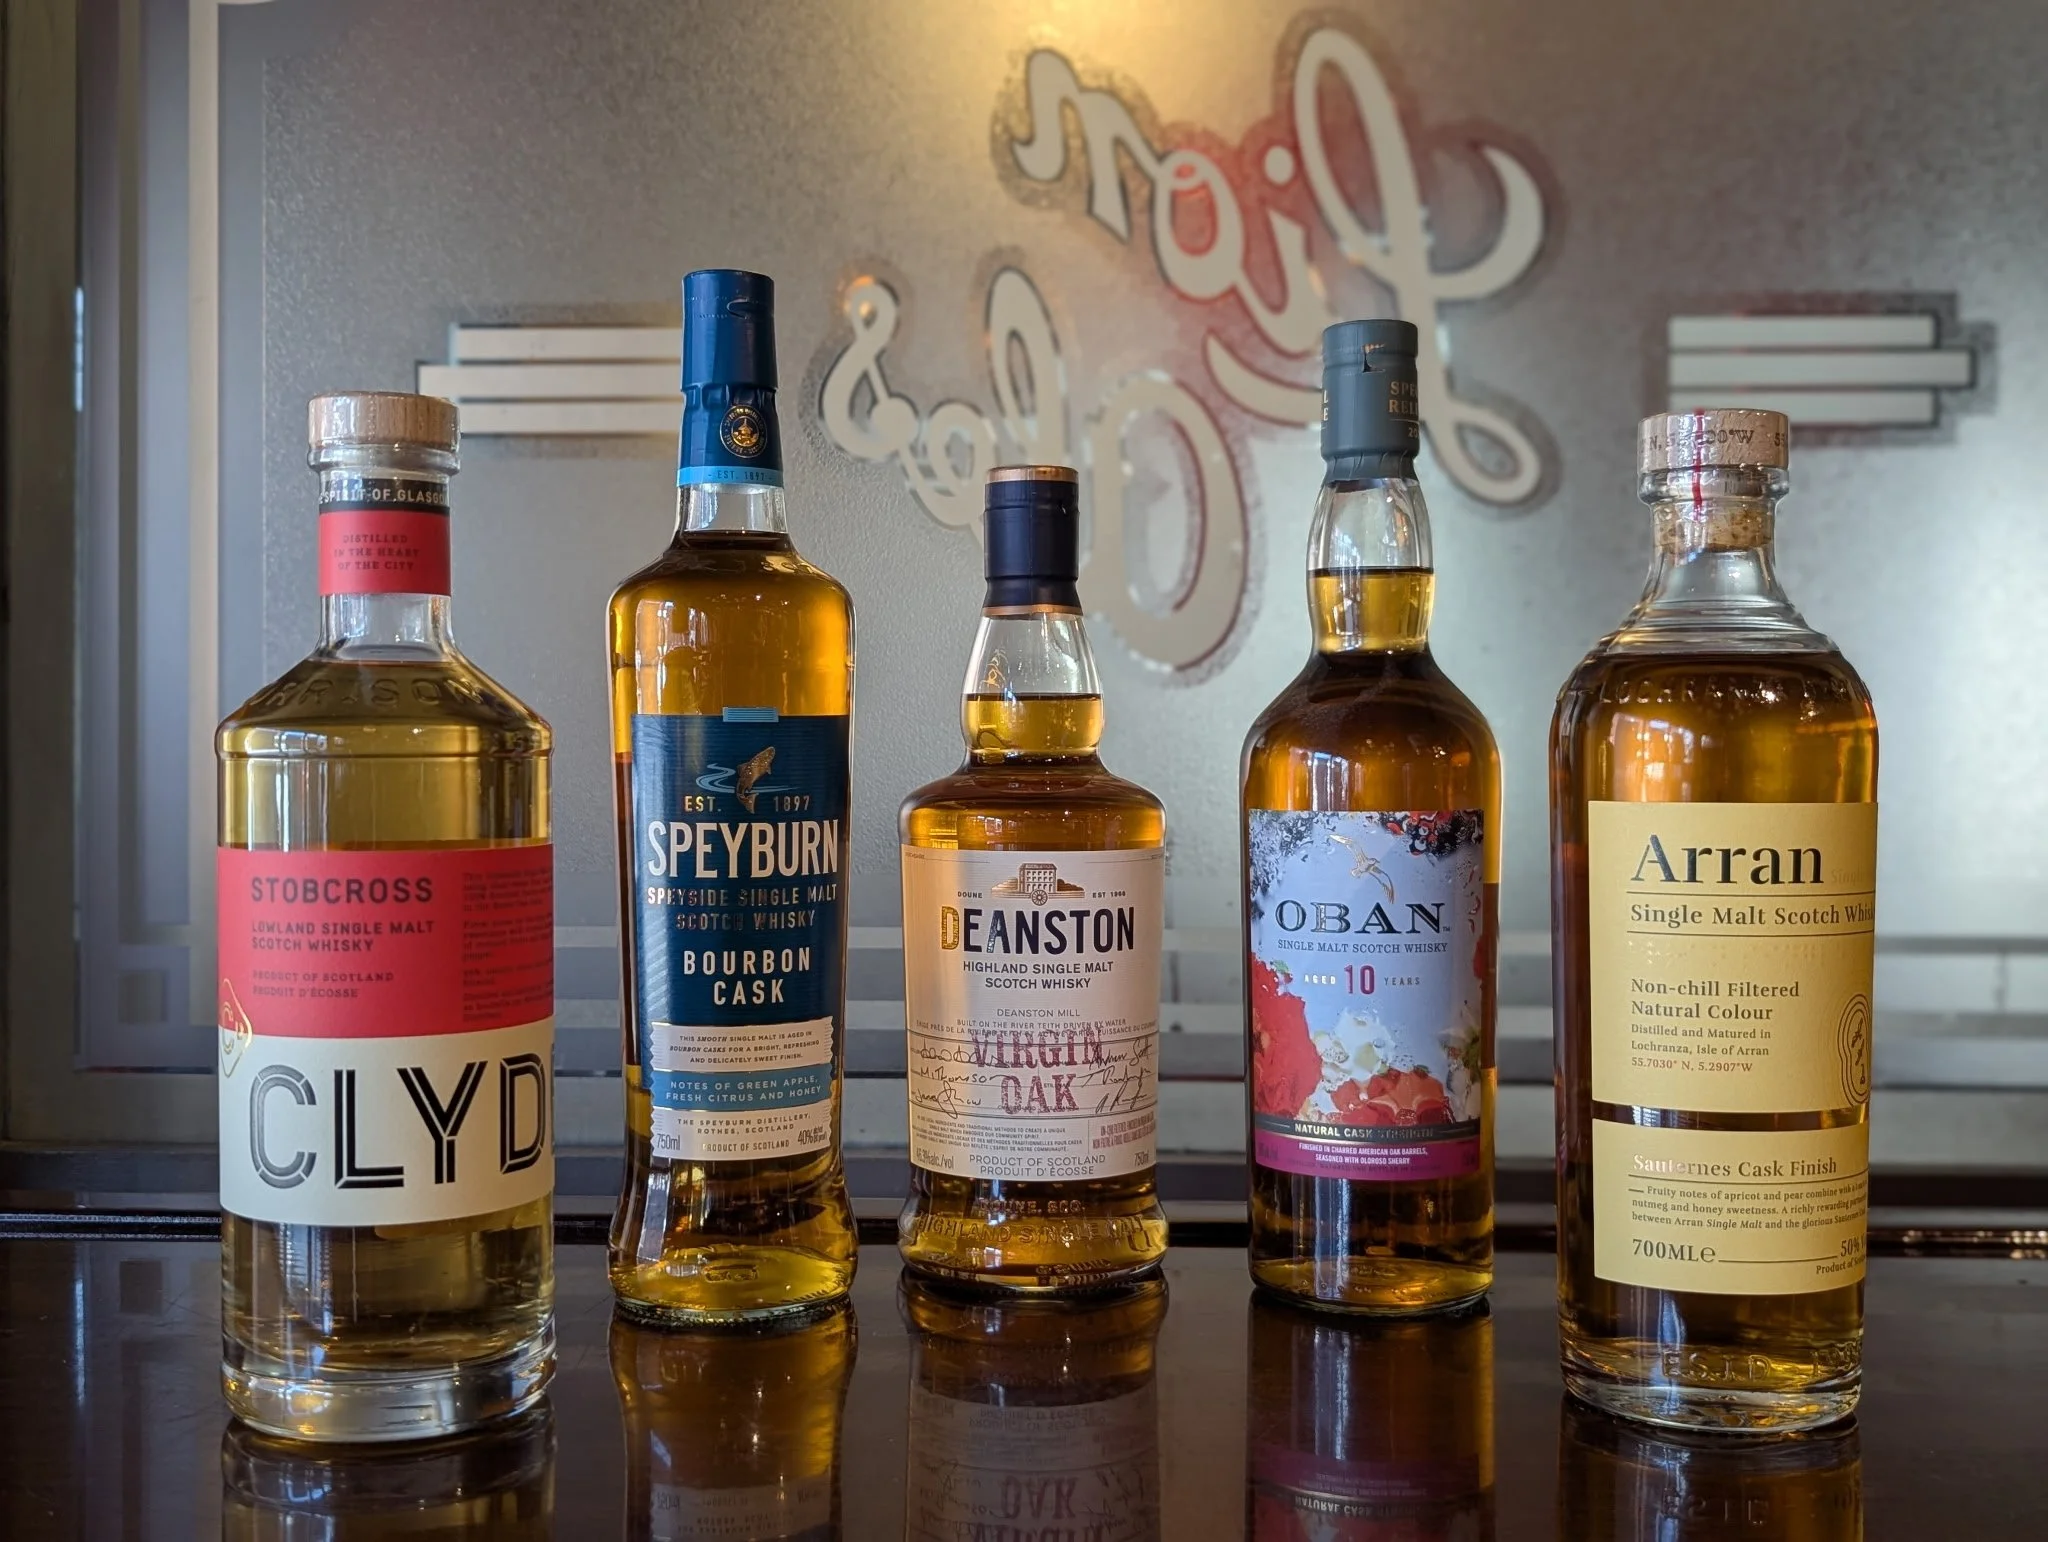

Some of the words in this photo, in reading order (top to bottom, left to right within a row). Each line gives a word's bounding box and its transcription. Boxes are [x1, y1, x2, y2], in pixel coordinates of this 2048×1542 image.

[372, 488, 392, 501] OF
[343, 534, 408, 544] DISTILLED
[350, 548, 372, 556] THE
[378, 548, 419, 558] HEART
[355, 562, 379, 570] THE
[384, 562, 414, 570] CITY
[685, 796, 721, 812] EST.
[774, 796, 811, 812] 1897
[648, 820, 838, 879] SPEYBURN
[1631, 834, 1824, 884] Arran
[252, 877, 433, 904] STOBCROSS
[648, 886, 728, 907] SPEYSIDE
[738, 887, 799, 907] SINGLE
[808, 884, 837, 903] MALT
[957, 891, 983, 899] DOUNE
[677, 912, 743, 930] SCOTCH
[754, 910, 815, 930] WHISKY
[1275, 899, 1444, 934] OBAN
[1631, 904, 1702, 928] Single
[1712, 906, 1766, 925] Malt
[1774, 906, 1840, 925] Scotch
[252, 922, 315, 935] LOWLAND
[322, 921, 382, 935] SINGLE
[390, 920, 434, 934] MALT
[941, 906, 1135, 954] DEANSTON
[252, 937, 302, 951] SCOTCH
[308, 938, 373, 952] WHISKY
[1278, 939, 1313, 950] SINGLE
[1317, 943, 1348, 953] MALT
[1353, 944, 1400, 954] SCOTCH
[1404, 943, 1448, 953] WHISKY
[684, 947, 810, 976] BOURBON
[963, 961, 1028, 974] HIGHLAND
[1032, 963, 1080, 974] SINGLE
[1085, 962, 1113, 973] MALT
[252, 970, 299, 982] PRODUCT
[303, 971, 318, 982] OF
[322, 972, 394, 982] SCOTLAND
[985, 978, 1037, 989] SCOTCH
[1041, 978, 1091, 989] WHISKY
[1305, 974, 1336, 984] AGED
[1344, 964, 1375, 995] 10
[1384, 977, 1420, 986] YEARS
[252, 986, 295, 998] PRODUIT
[300, 986, 359, 998] D'ÉCOSSE
[713, 979, 784, 1006] CASK
[1631, 978, 1720, 997] Non-chill
[1727, 982, 1800, 997] Filtered
[997, 1009, 1054, 1017] DEANSTON
[1058, 1009, 1080, 1017] MILL
[1631, 1001, 1700, 1018] Natural
[1707, 1004, 1773, 1020] Colour
[957, 1019, 976, 1027] BUILT
[979, 1020, 990, 1028] ON
[1011, 1021, 1034, 1029] RIVER
[1038, 1021, 1060, 1029] TEITH
[1105, 1019, 1126, 1027] WATER
[1631, 1024, 1678, 1037] Distilled
[1681, 1026, 1703, 1038] and
[1707, 1028, 1756, 1039] Matured
[1760, 1028, 1771, 1039] in
[784, 1040, 819, 1050] REFRESHING
[970, 1028, 1105, 1069] VIRGIN
[1631, 1040, 1693, 1055] Lochranza,
[1696, 1044, 1717, 1055] Isle
[1721, 1044, 1734, 1055] of
[1737, 1046, 1769, 1056] Arran
[671, 1081, 708, 1090] NOTES
[715, 1082, 730, 1090] OF
[737, 1080, 777, 1090] GREEN
[783, 1075, 818, 1086] APPLE,
[666, 1092, 701, 1102] FRESH
[708, 1093, 753, 1102] CITRUS
[760, 1091, 784, 1100] AND
[789, 1085, 821, 1097] HONEY
[1000, 1074, 1079, 1114] OAK
[250, 1053, 555, 1190] CLYD
[745, 1124, 794, 1134] SCOTLAND
[1295, 1123, 1340, 1136] NATURAL
[1344, 1128, 1373, 1138] CASK
[656, 1134, 680, 1150] 750ml
[703, 1143, 738, 1152] PRODUCT
[740, 1143, 749, 1151] OF
[752, 1139, 790, 1150] SCOTLAND
[1299, 1143, 1322, 1152] FINISHED
[1331, 1146, 1357, 1154] CHARRED
[1402, 1147, 1428, 1155] BARRELS,
[969, 1154, 1022, 1166] PRODUCT
[1027, 1158, 1042, 1167] OF
[1047, 1155, 1105, 1167] SCOTLAND
[1315, 1154, 1344, 1163] SEASONED
[1360, 1157, 1387, 1165] OLOROSO
[1634, 1154, 1730, 1176] Sauternes
[1738, 1160, 1784, 1176] Cask
[1790, 1157, 1837, 1176] Finish
[980, 1166, 1031, 1176] PRODUIT
[1647, 1185, 1676, 1198] Fruity
[1680, 1188, 1708, 1199] notes
[1711, 1189, 1722, 1200] of
[1724, 1190, 1761, 1202] apricot
[1764, 1190, 1781, 1200] and
[1784, 1192, 1803, 1203] pear
[1806, 1187, 1837, 1199] combine
[1632, 1199, 1668, 1213] nutmeg
[1670, 1202, 1689, 1212] and
[1692, 1204, 1723, 1215] honey
[1727, 1205, 1778, 1214] sweetness.
[1782, 1205, 1788, 1214] A
[1791, 1204, 1815, 1216] richly
[1816, 1200, 1849, 1212] rewarding
[1632, 1211, 1672, 1224] between
[1674, 1217, 1703, 1226] Arran
[1706, 1217, 1737, 1230] Single
[1740, 1219, 1762, 1229] Malt
[1765, 1219, 1782, 1229] and
[1785, 1218, 1800, 1228] the
[1802, 1218, 1832, 1229] glorious
[1840, 1237, 1860, 1257] 50%
[1816, 1262, 1846, 1274] Product
